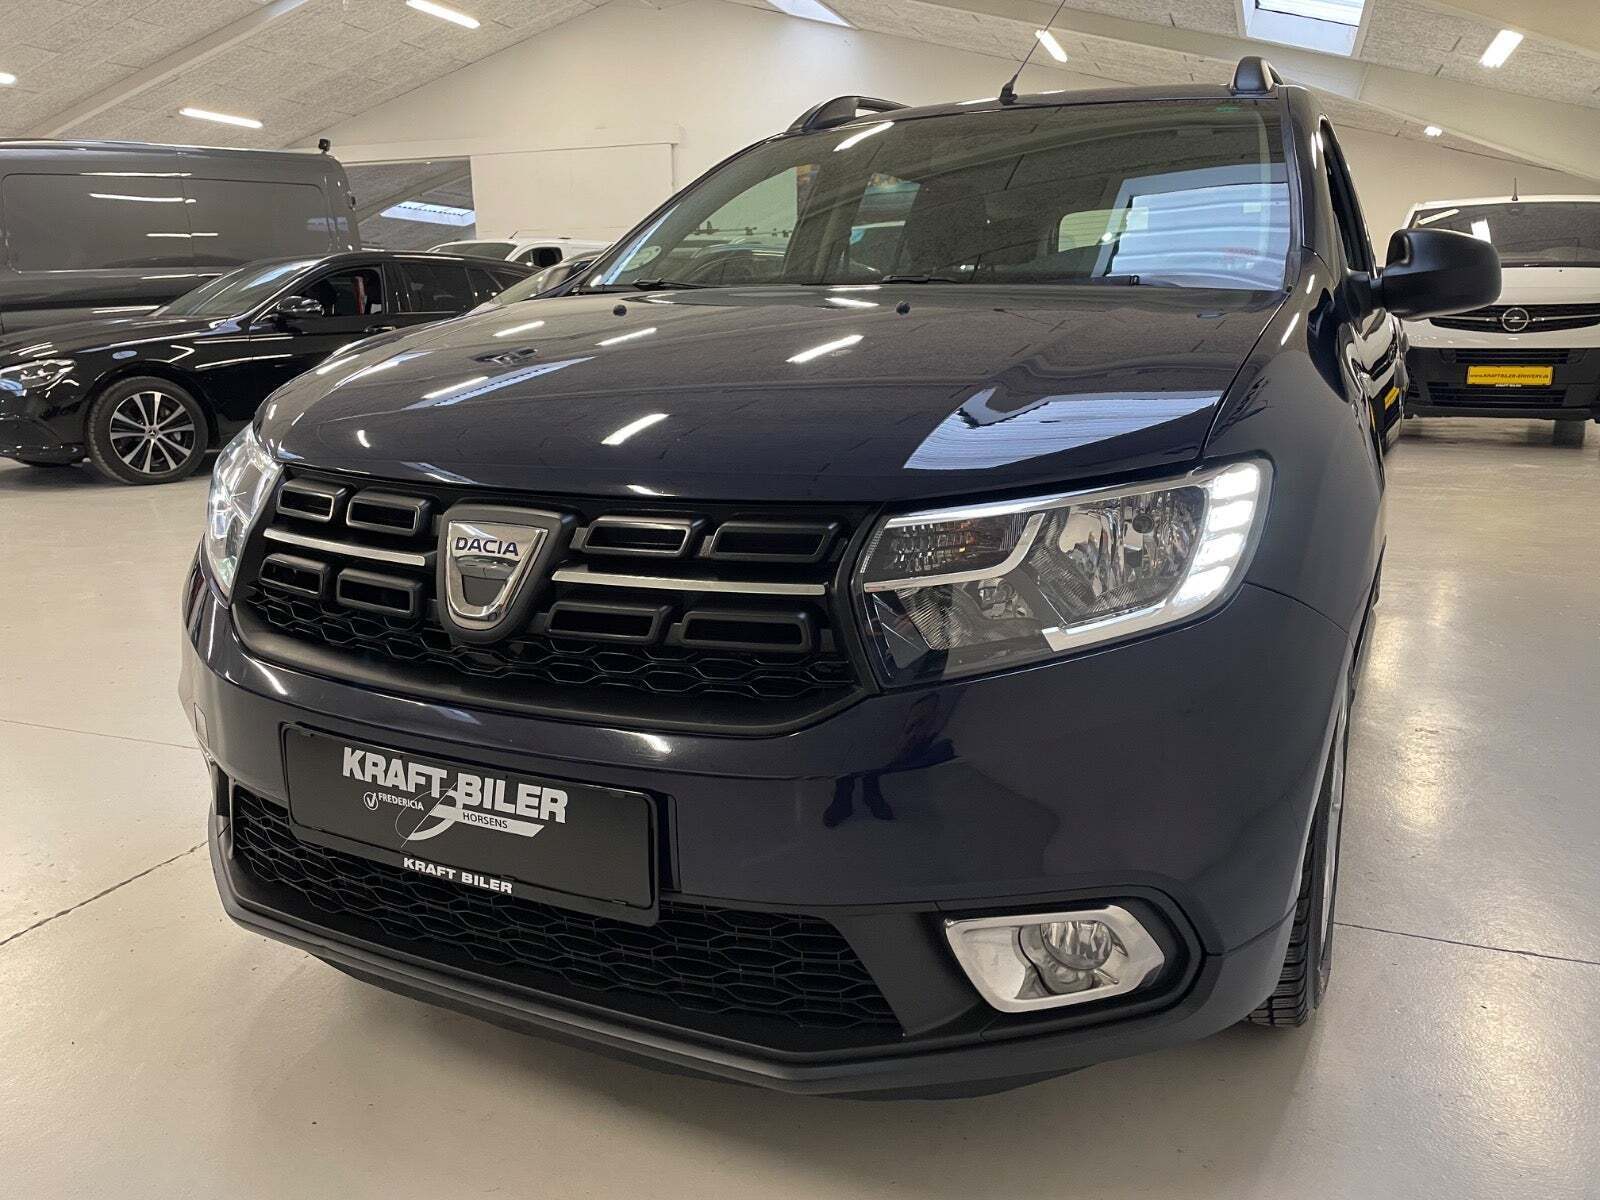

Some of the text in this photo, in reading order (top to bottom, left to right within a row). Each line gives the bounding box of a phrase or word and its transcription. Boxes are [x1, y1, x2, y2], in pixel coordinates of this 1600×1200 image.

[455, 536, 519, 556] DACIA
[342, 746, 569, 823] KRAFT BILER
[378, 792, 424, 811] FREDERICIA
[462, 812, 508, 829] HORSENS
[403, 857, 513, 894] KRAFT BILER
